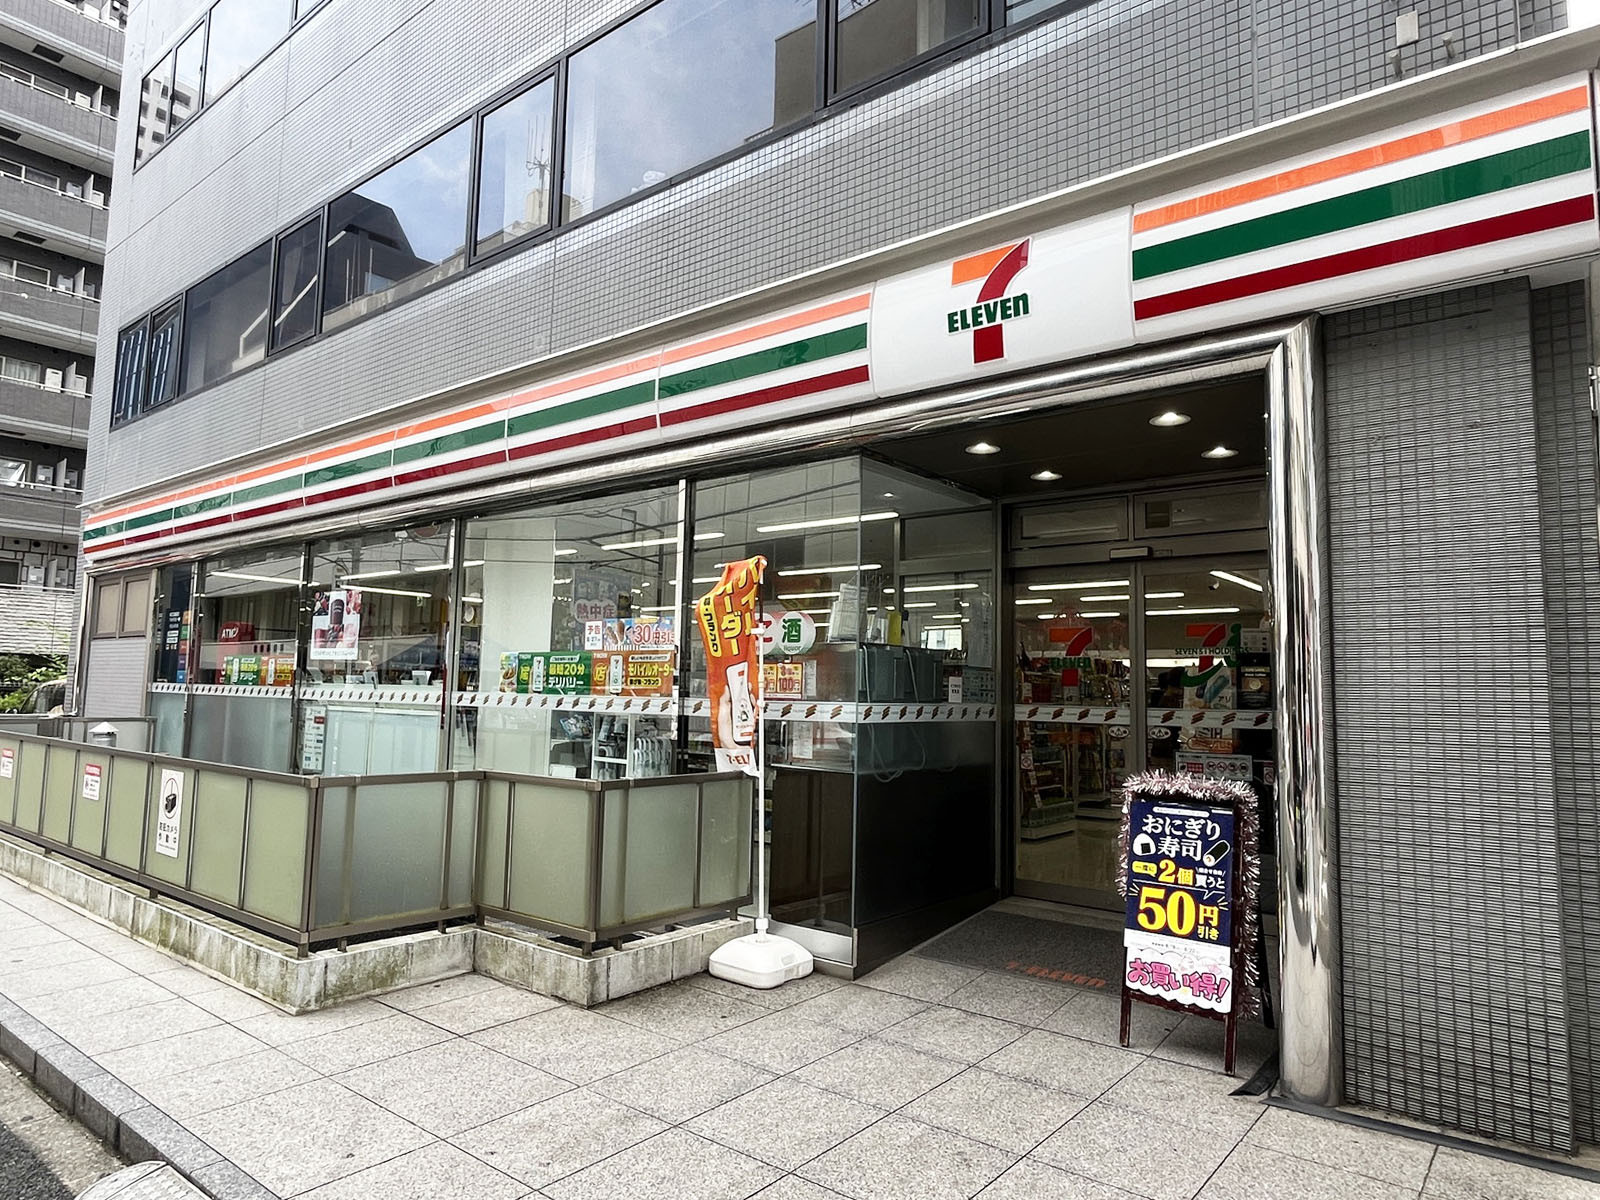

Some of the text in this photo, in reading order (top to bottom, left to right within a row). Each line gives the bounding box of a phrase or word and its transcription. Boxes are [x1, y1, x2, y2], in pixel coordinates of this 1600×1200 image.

[951, 237, 1030, 364] 7
[782, 618, 802, 643] 酒
[1175, 647, 1198, 656] SEVEN
[548, 676, 584, 688] デリバリー
[1142, 814, 1221, 841] おにぎり
[1157, 836, 1202, 862] 寿司
[1127, 957, 1231, 1003] お買い得!
